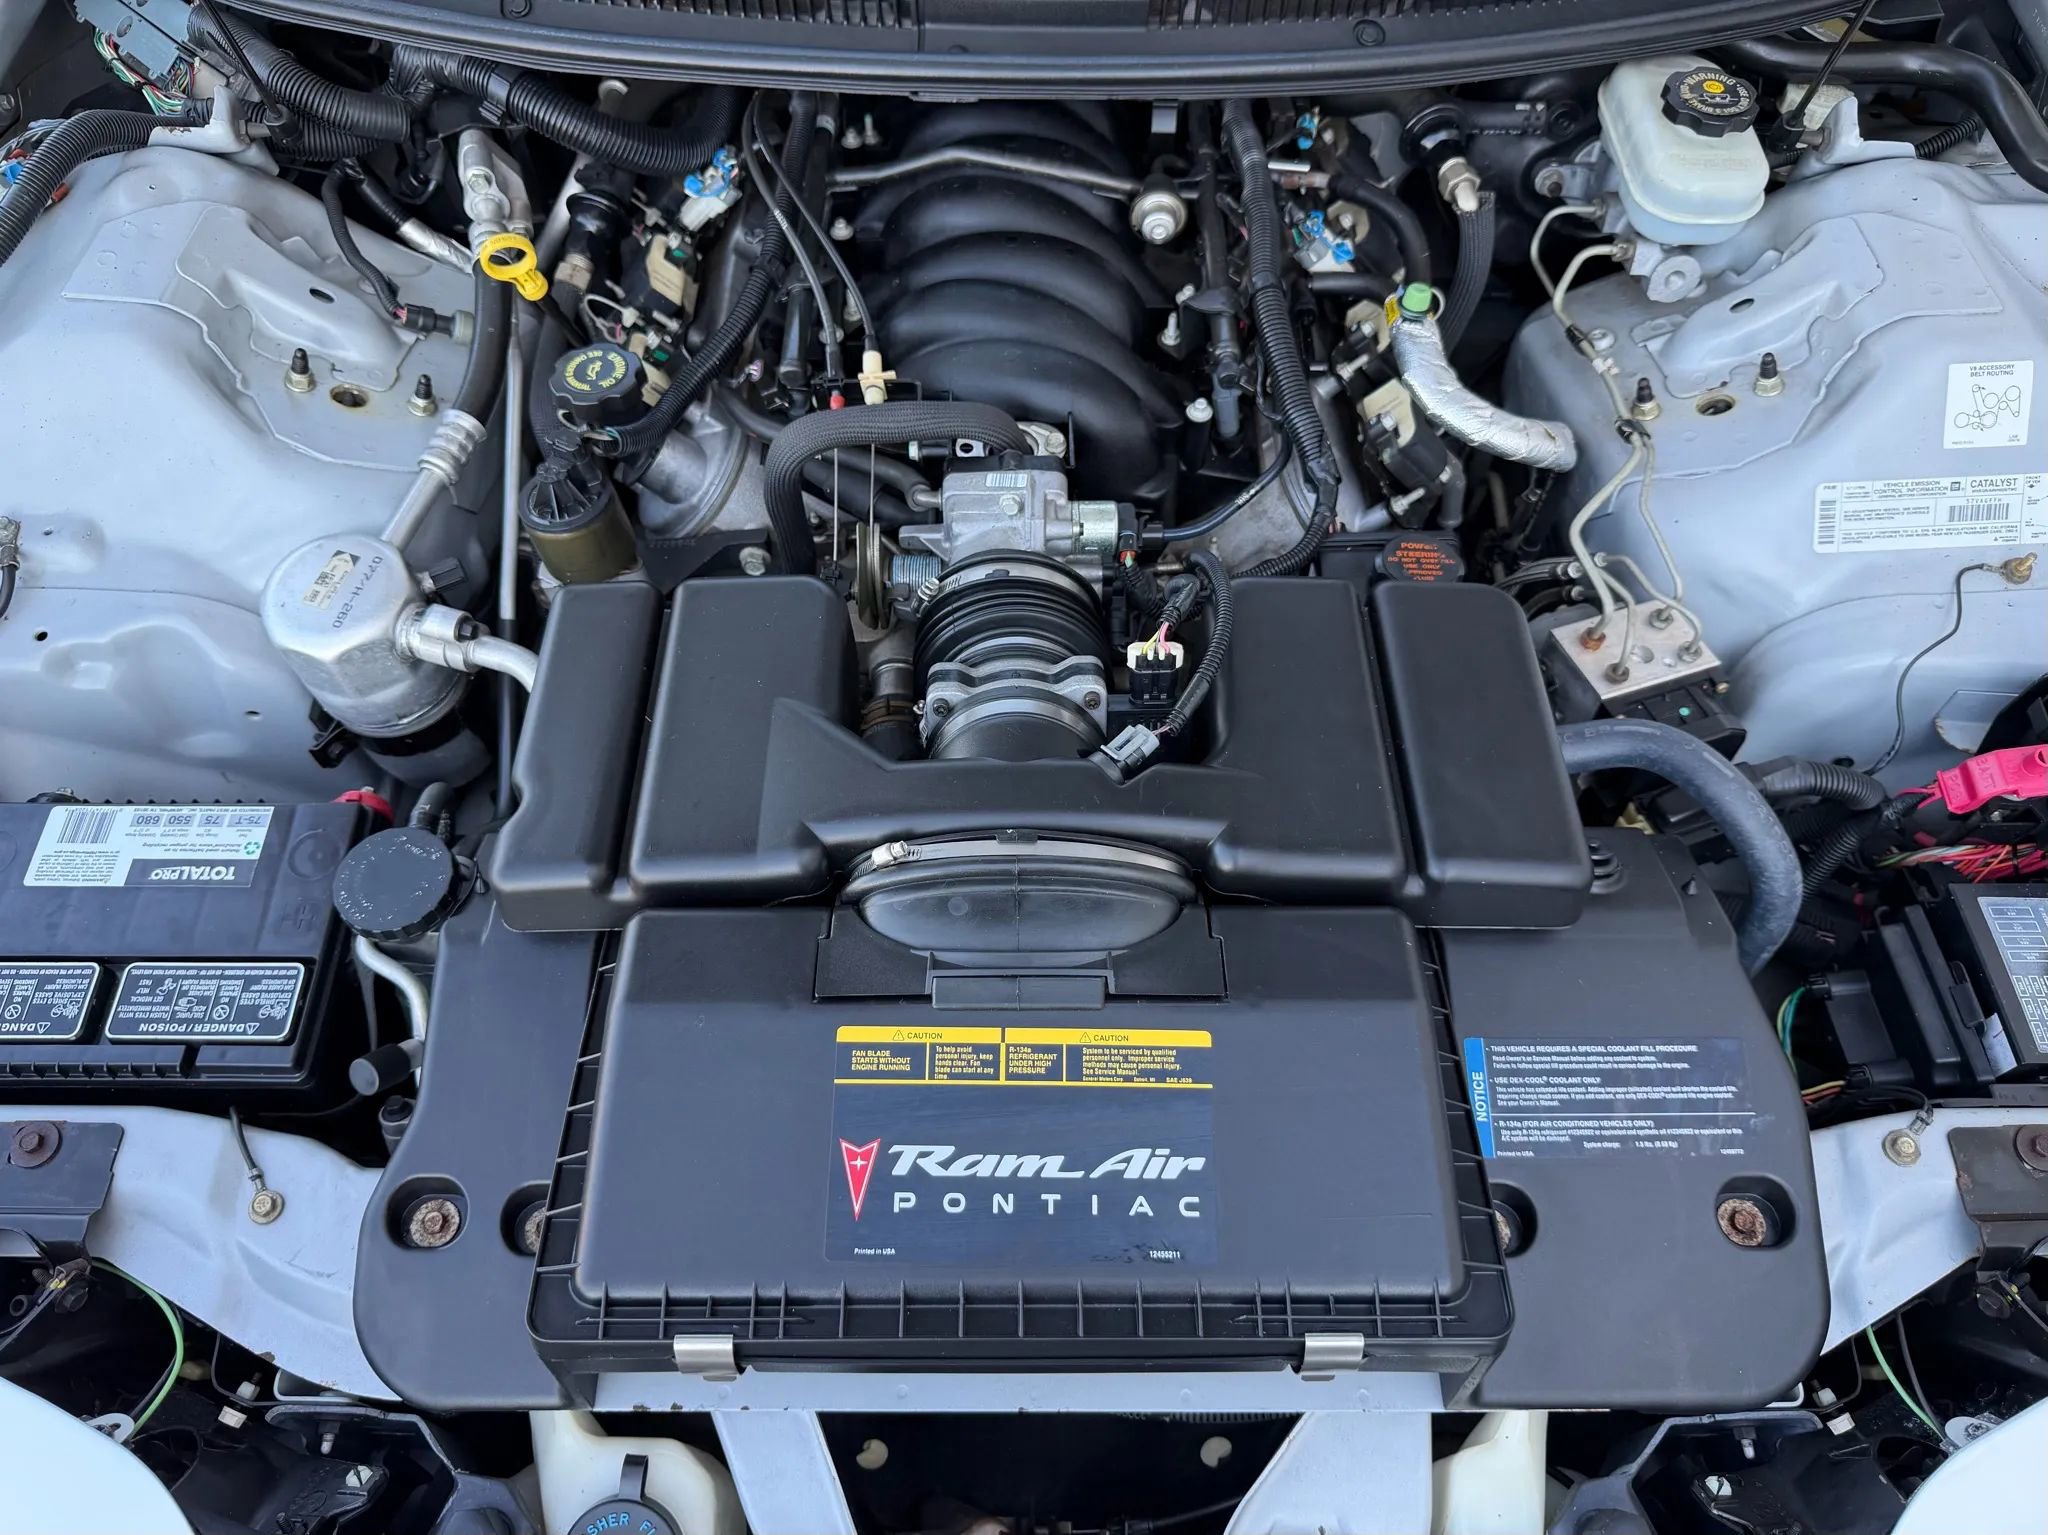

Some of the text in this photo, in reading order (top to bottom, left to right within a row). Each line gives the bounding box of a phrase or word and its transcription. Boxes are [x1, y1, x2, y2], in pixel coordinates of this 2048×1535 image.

[1684, 73, 1736, 86] WARNING
[598, 352, 625, 388] ENGINE OIL
[1970, 478, 2018, 488] CATALYST
[136, 815, 262, 824] 75-T 75 550 680
[148, 866, 235, 880] TOTALPRO
[0, 1023, 36, 1031] DANG
[1094, 1034, 1129, 1042] CAUTION
[979, 1053, 993, 1061] keep
[1111, 1055, 1124, 1063] only.
[1119, 1068, 1139, 1076] Manual.
[1472, 1071, 1488, 1122] NOTICE
[887, 1144, 1206, 1179] Ram Air
[893, 1192, 1201, 1218] PONTIAC
[854, 1247, 896, 1256] Printed in USA
[1149, 1250, 1181, 1259] 12455211
[587, 1512, 630, 1535] SHER
